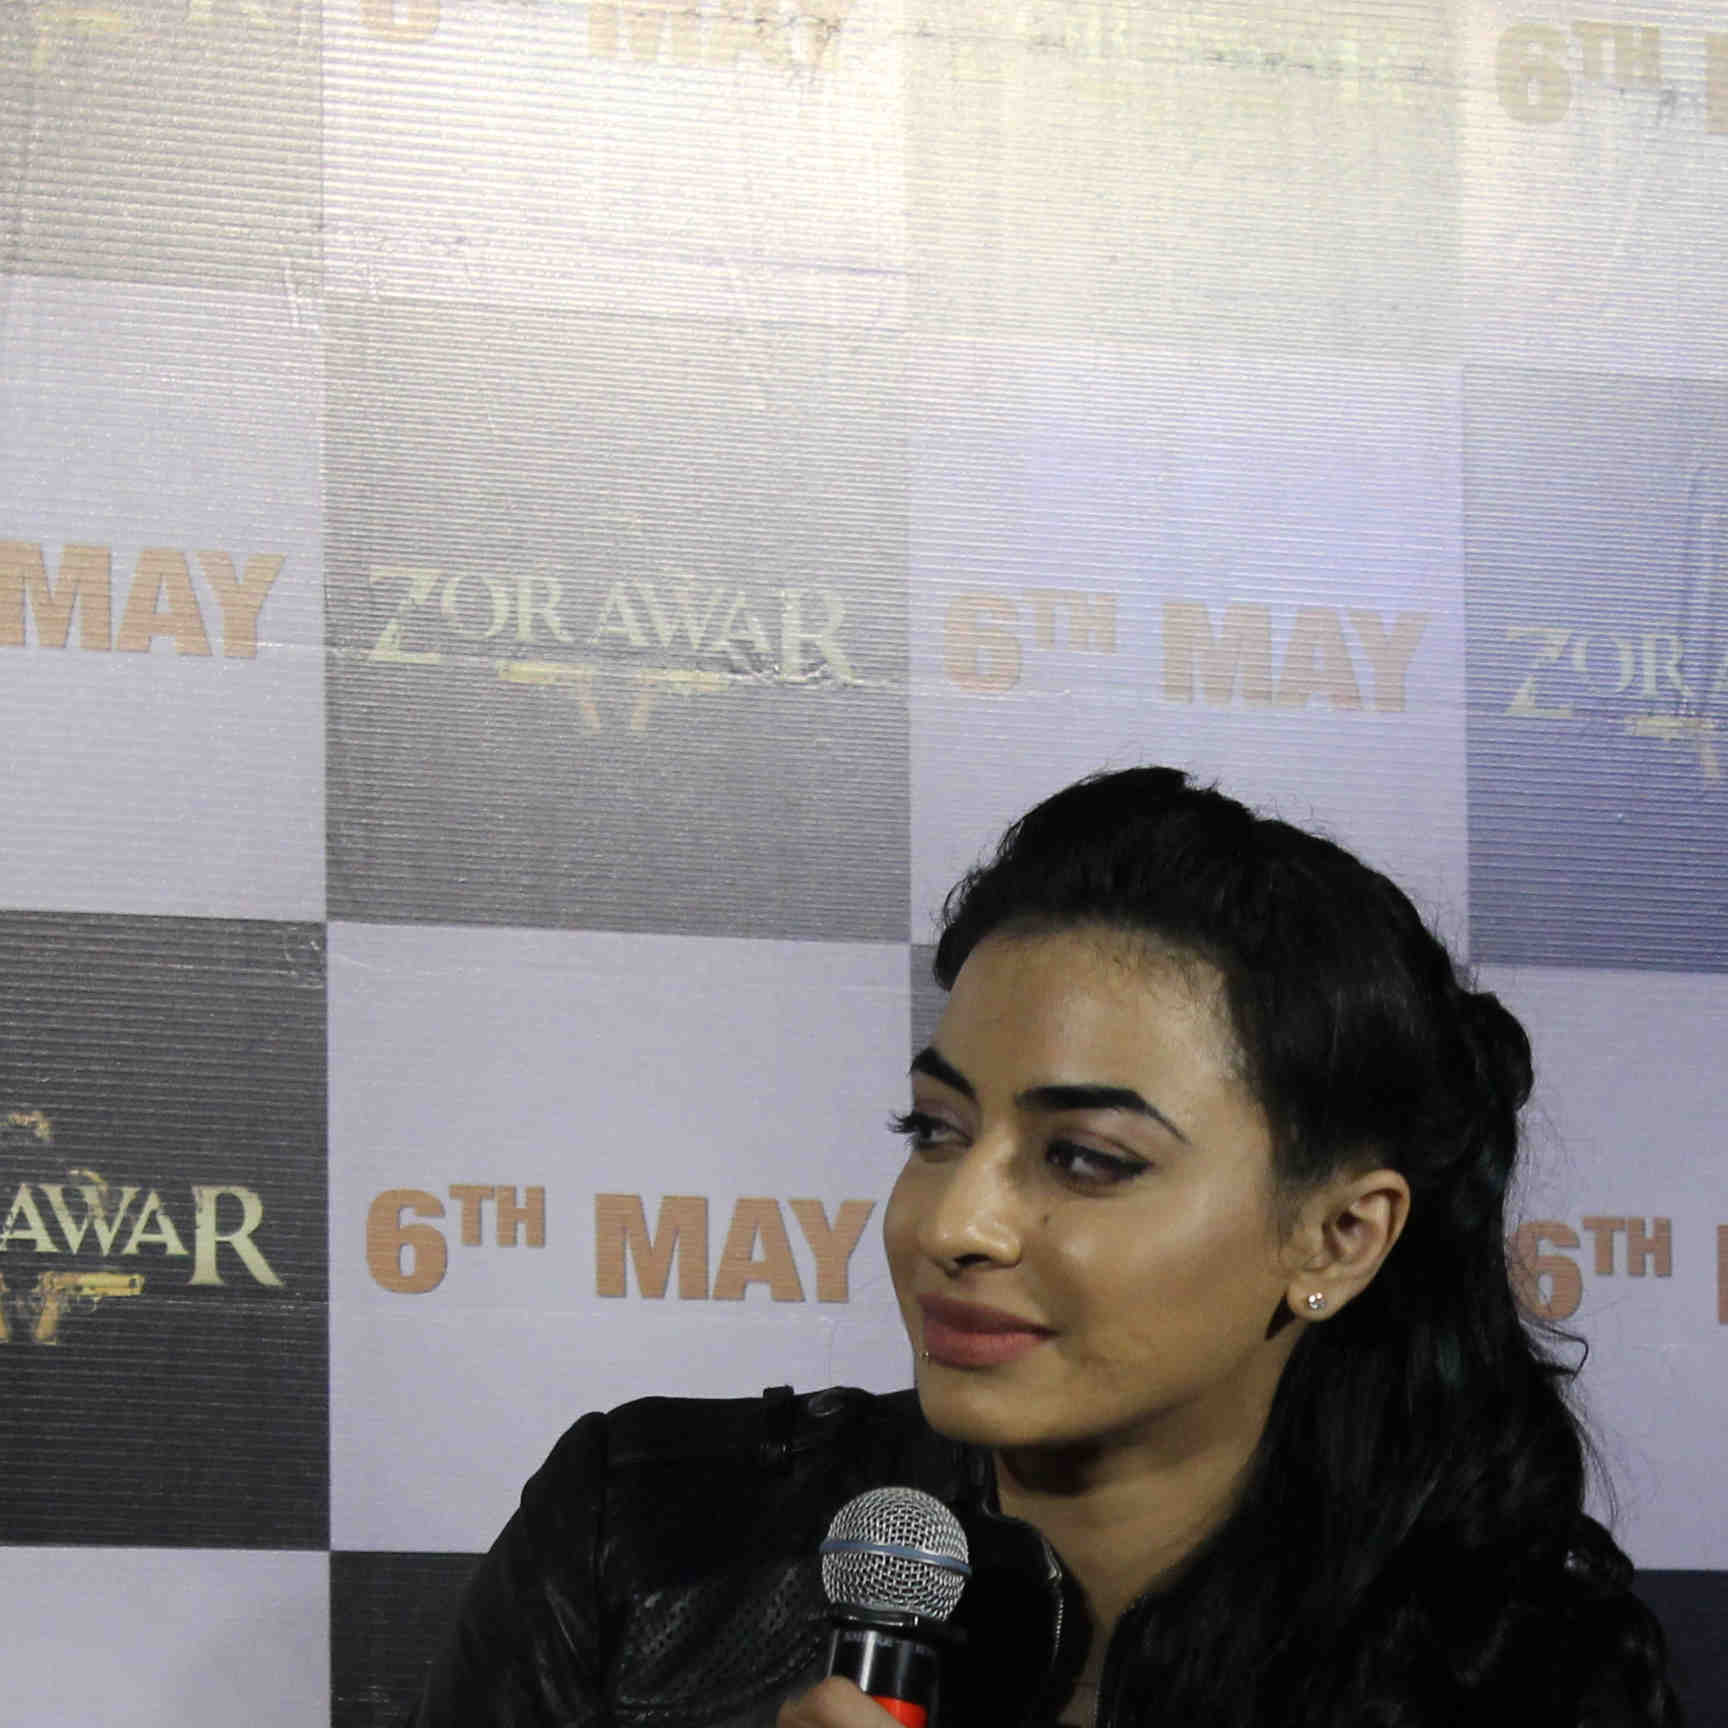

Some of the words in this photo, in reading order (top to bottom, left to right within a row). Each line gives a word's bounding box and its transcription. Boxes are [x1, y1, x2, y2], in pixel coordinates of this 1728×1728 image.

[1496, 22, 1663, 124] 6TH
[942, 590, 1118, 695] 6TH
[1163, 600, 1428, 713] MAY
[364, 1185, 547, 1294] 6TH
[595, 1194, 874, 1303] MAY
[1511, 1217, 1672, 1321] 6TH
